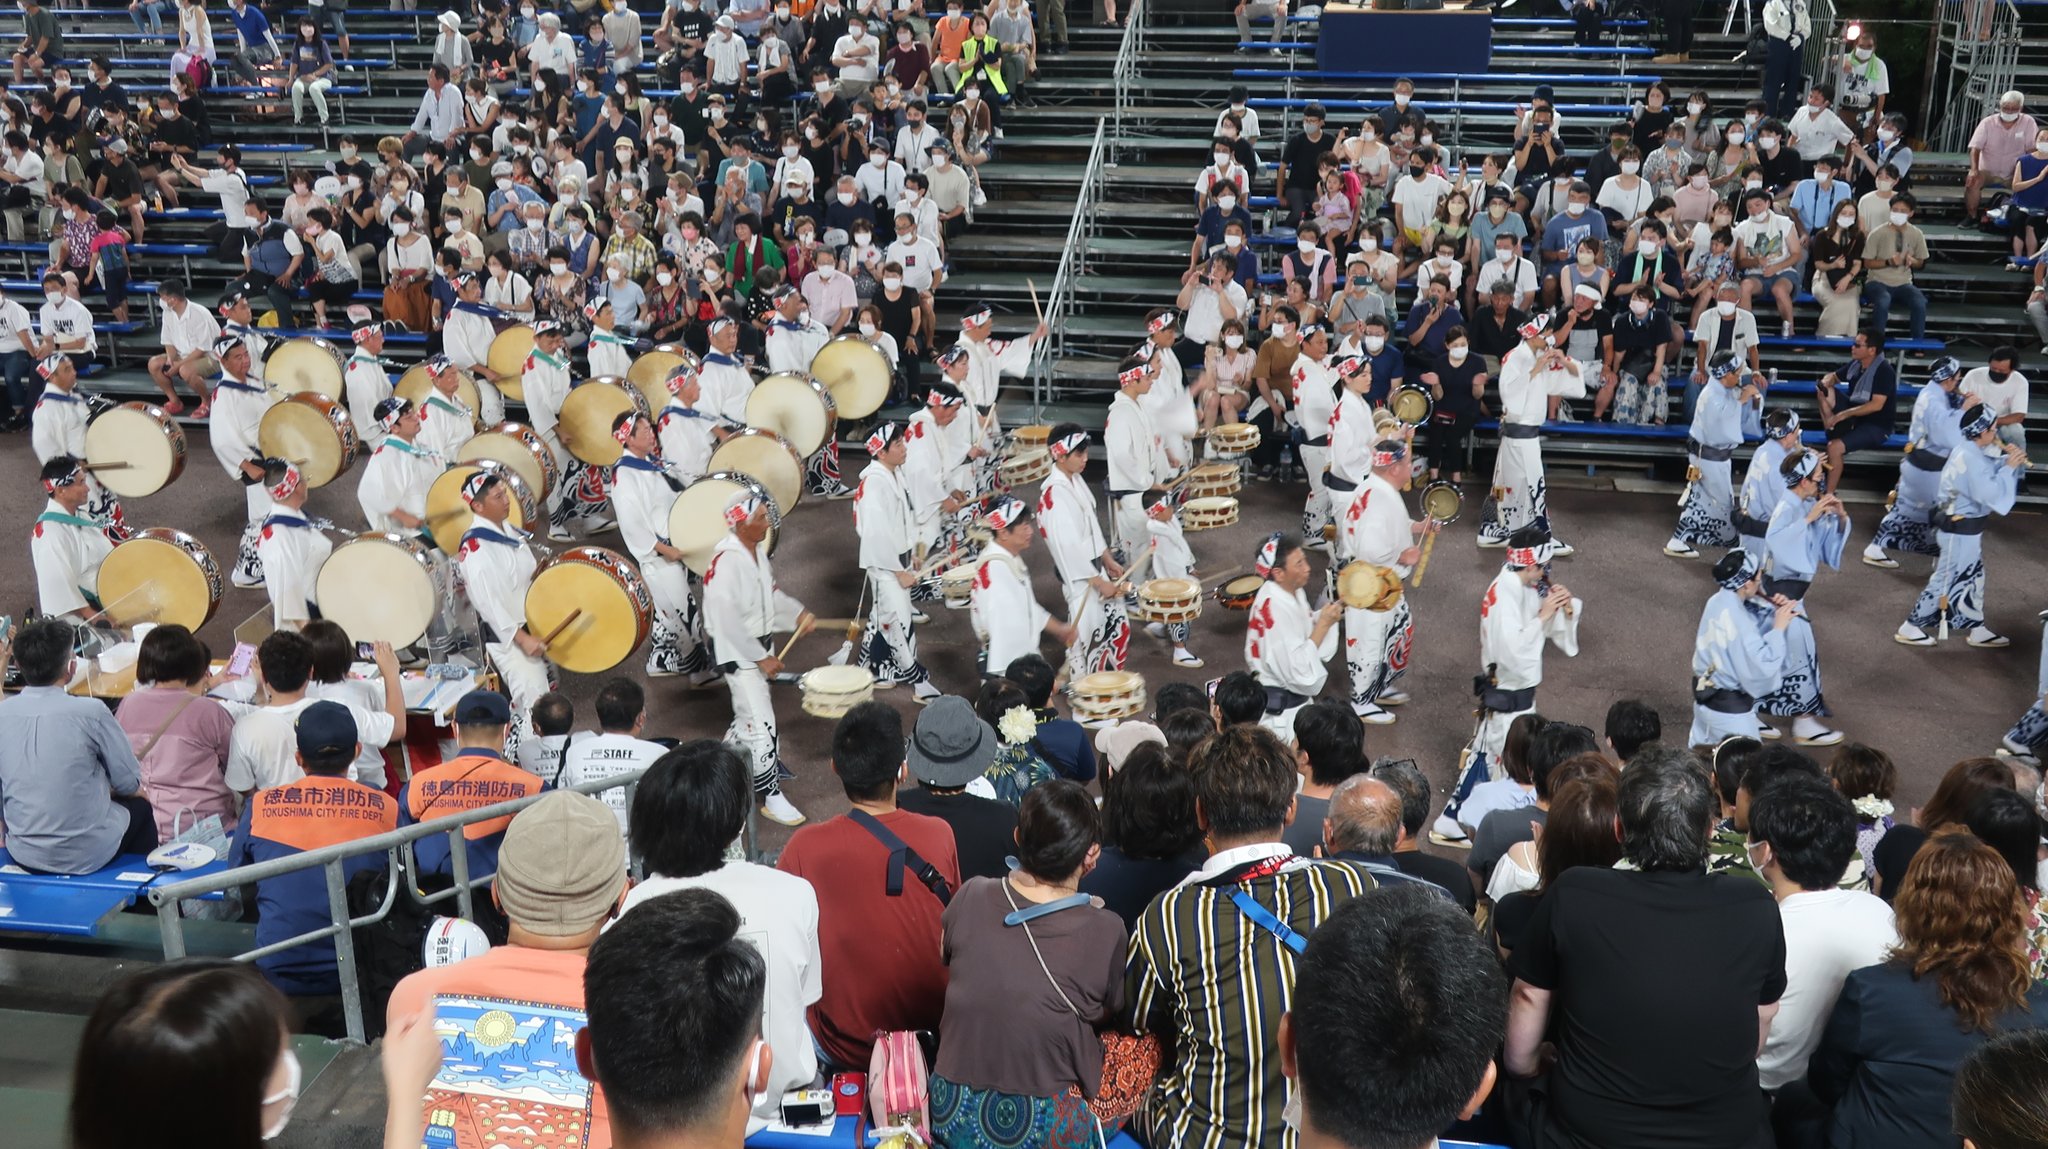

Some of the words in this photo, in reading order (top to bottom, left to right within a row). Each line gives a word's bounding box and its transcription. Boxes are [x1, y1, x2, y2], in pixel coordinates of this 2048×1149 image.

[603, 749, 634, 759] STAFF
[421, 780, 526, 798] 徳島市消防局
[264, 787, 385, 811] 徳島市消防局
[262, 807, 313, 818] TOKUSHIMA
[316, 808, 338, 818] CITY
[340, 808, 360, 819] FIRE
[362, 810, 385, 824] DEPT.
